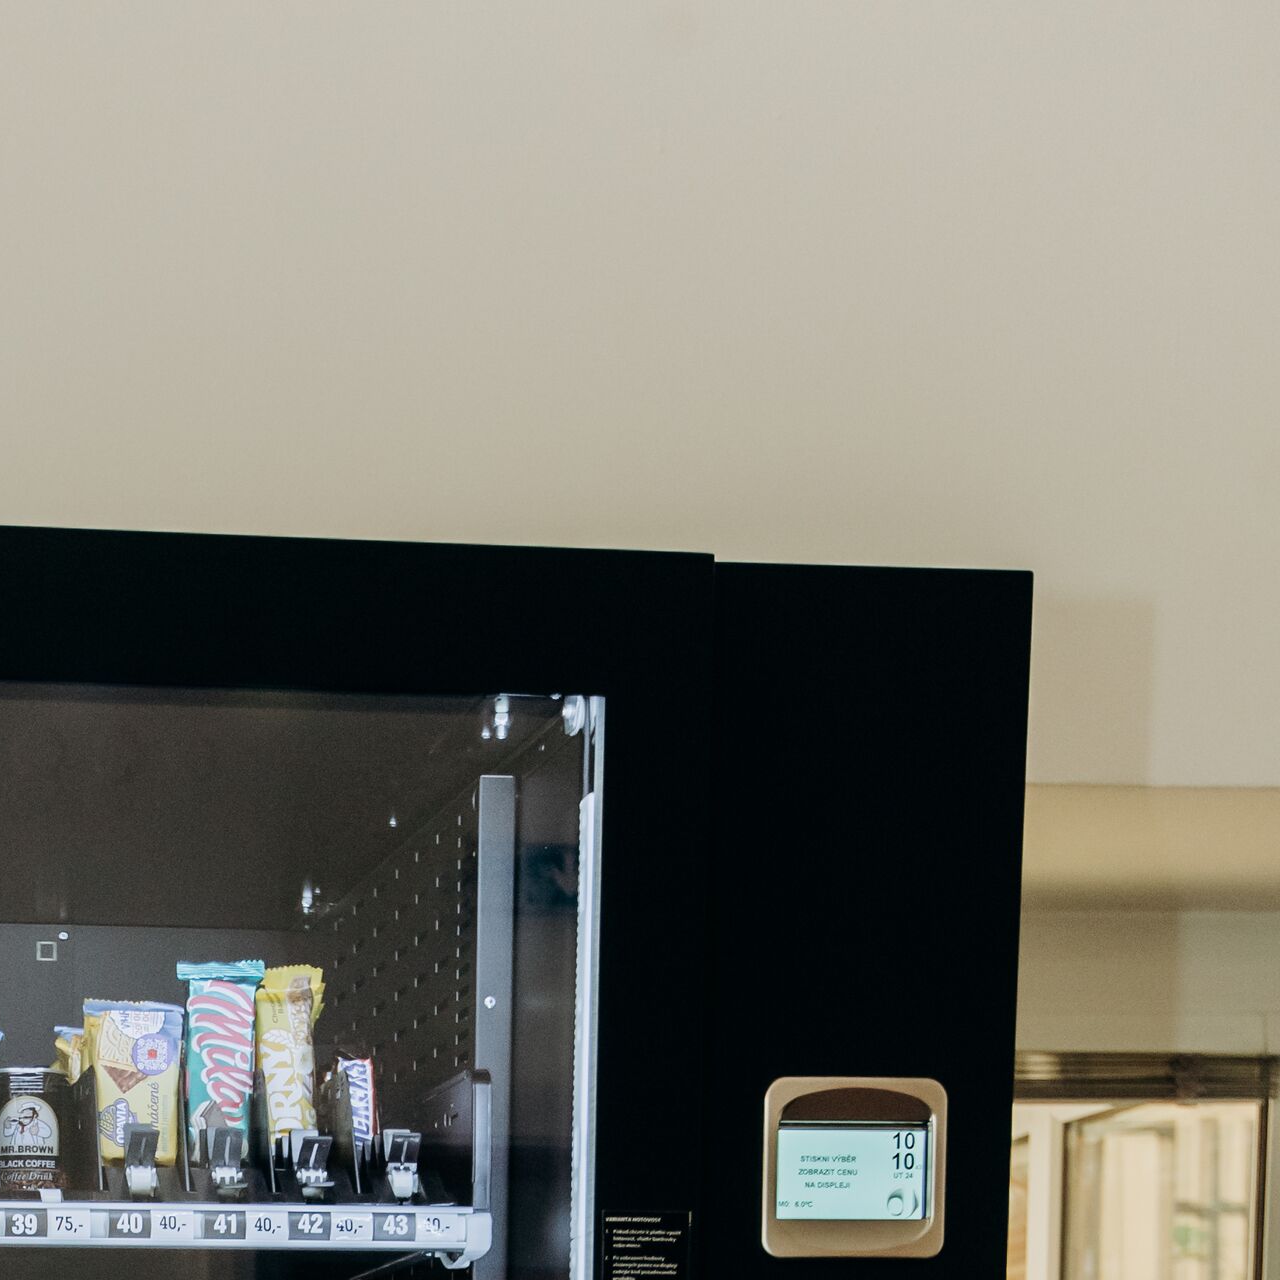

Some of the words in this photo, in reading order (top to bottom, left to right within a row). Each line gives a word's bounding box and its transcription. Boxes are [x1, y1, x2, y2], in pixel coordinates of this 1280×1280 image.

[187, 980, 255, 1127] Milka
[262, 1040, 303, 1131] ORNY
[115, 1101, 128, 1145] OPAVIA
[1, 1145, 54, 1155] MR.BROWN
[891, 1131, 915, 1150] 10
[0, 1160, 24, 1169] BLACK
[25, 1160, 56, 1169] COFFEE
[800, 1155, 830, 1163] STISKNI
[891, 1152, 915, 1170] 10
[797, 1168, 834, 1176] ZOBRAZIT
[836, 1168, 858, 1176] CENU
[804, 1181, 815, 1189] NA
[11, 1213, 38, 1235] 39
[55, 1216, 83, 1233] 75,-
[117, 1213, 143, 1234] 40
[160, 1216, 186, 1232] 40,-
[213, 1213, 237, 1234] 41
[254, 1217, 281, 1234] 40,-
[297, 1213, 323, 1234] 42
[336, 1218, 363, 1234] 40,-
[383, 1214, 409, 1235] 43
